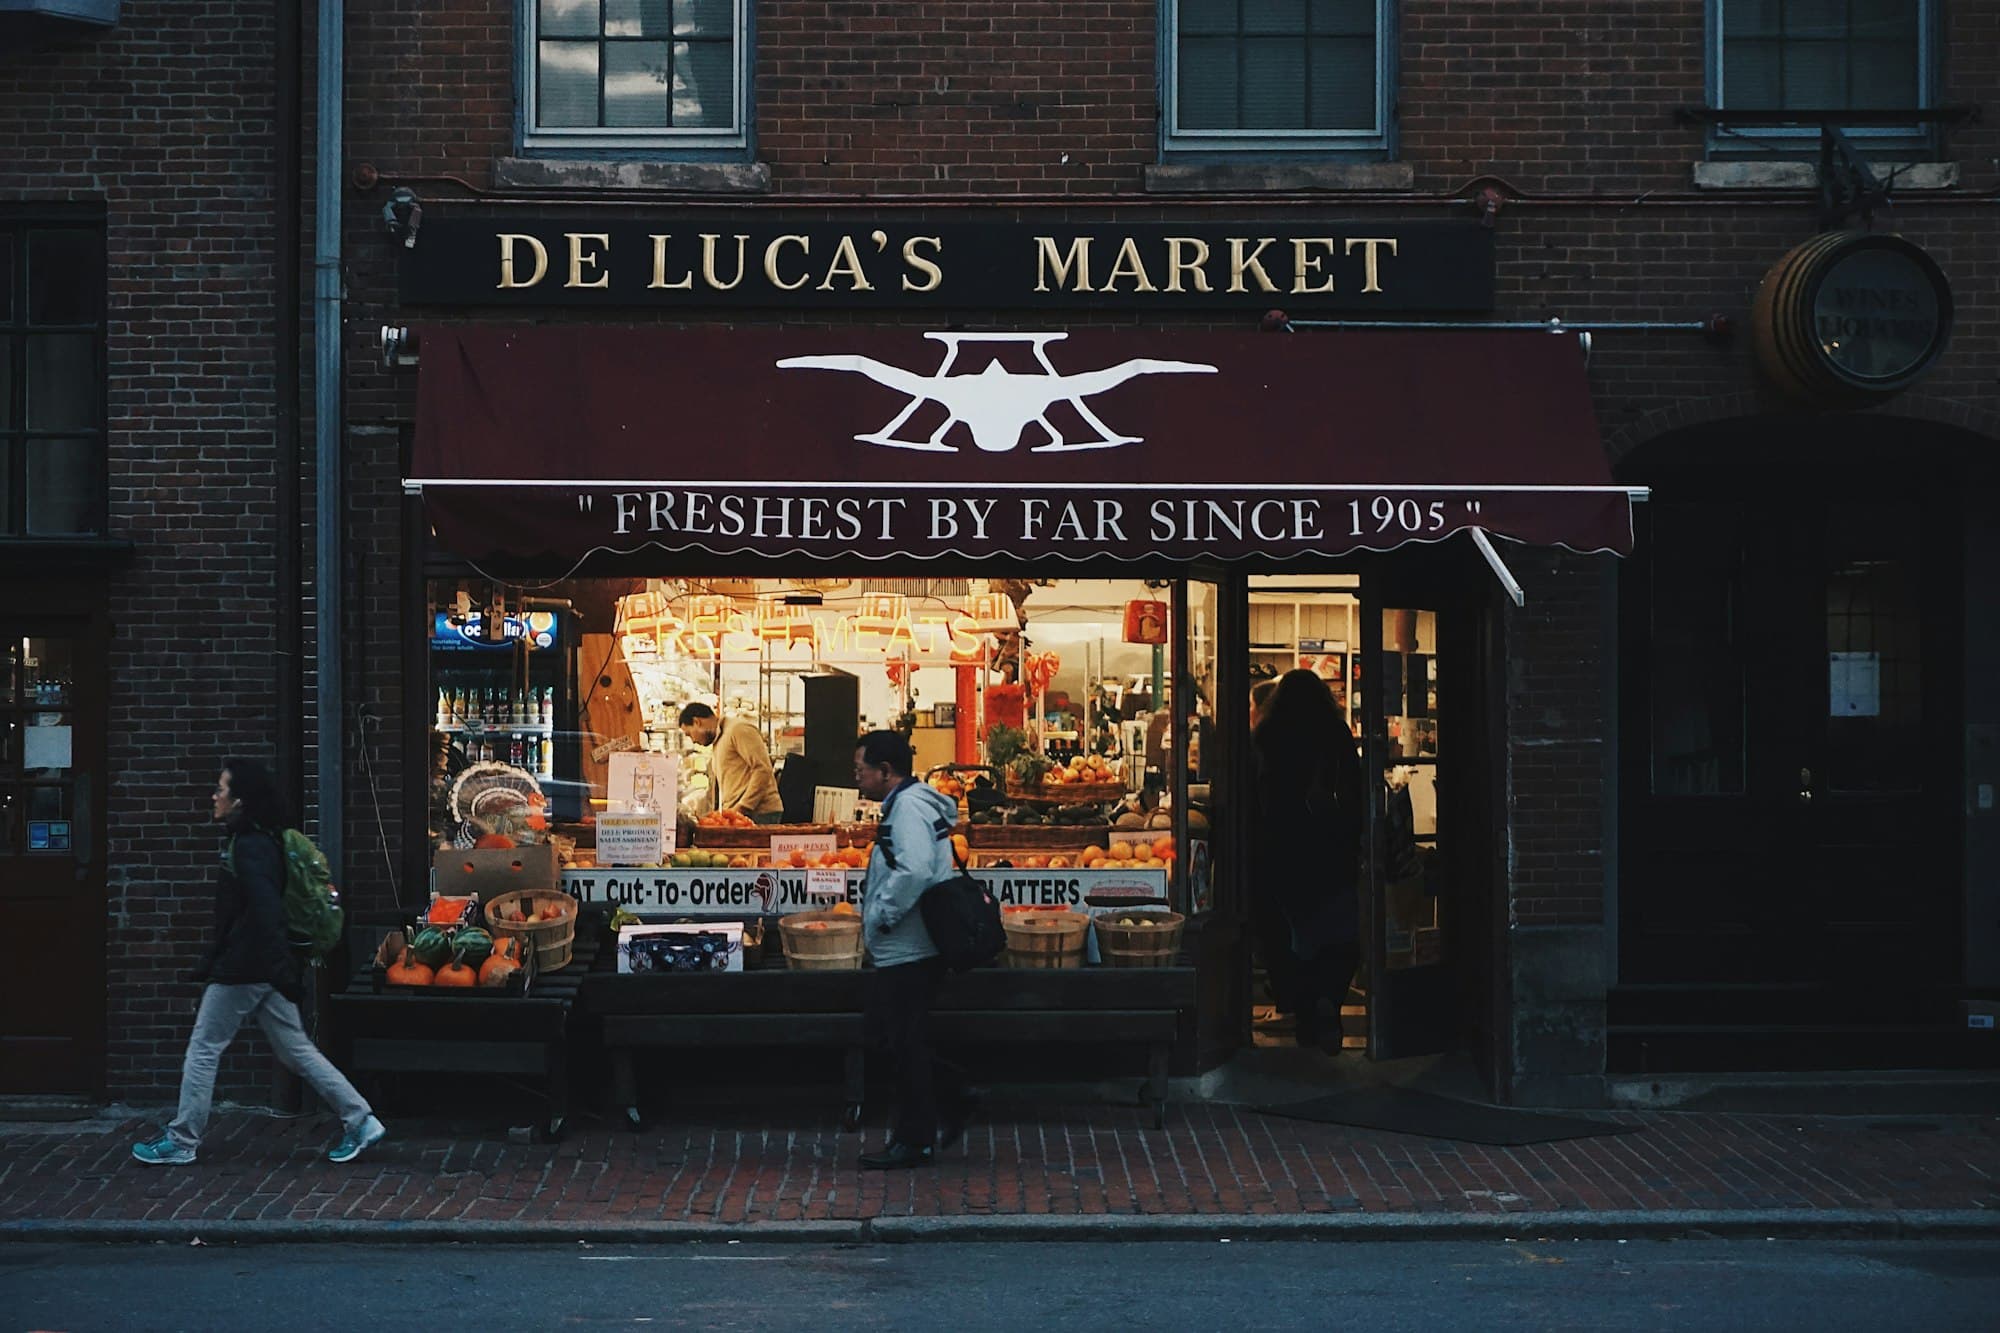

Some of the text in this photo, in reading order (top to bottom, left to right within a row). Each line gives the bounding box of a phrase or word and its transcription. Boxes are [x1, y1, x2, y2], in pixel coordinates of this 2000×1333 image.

[496, 230, 1397, 294] DE LUCA'S MARKET
[612, 490, 907, 541] FRESHEST
[927, 499, 998, 541] BY
[1019, 499, 1129, 541] FAR
[1150, 498, 1324, 541] SINCE
[1347, 495, 1446, 535] 1905
[626, 615, 981, 656] FRESH MEATS
